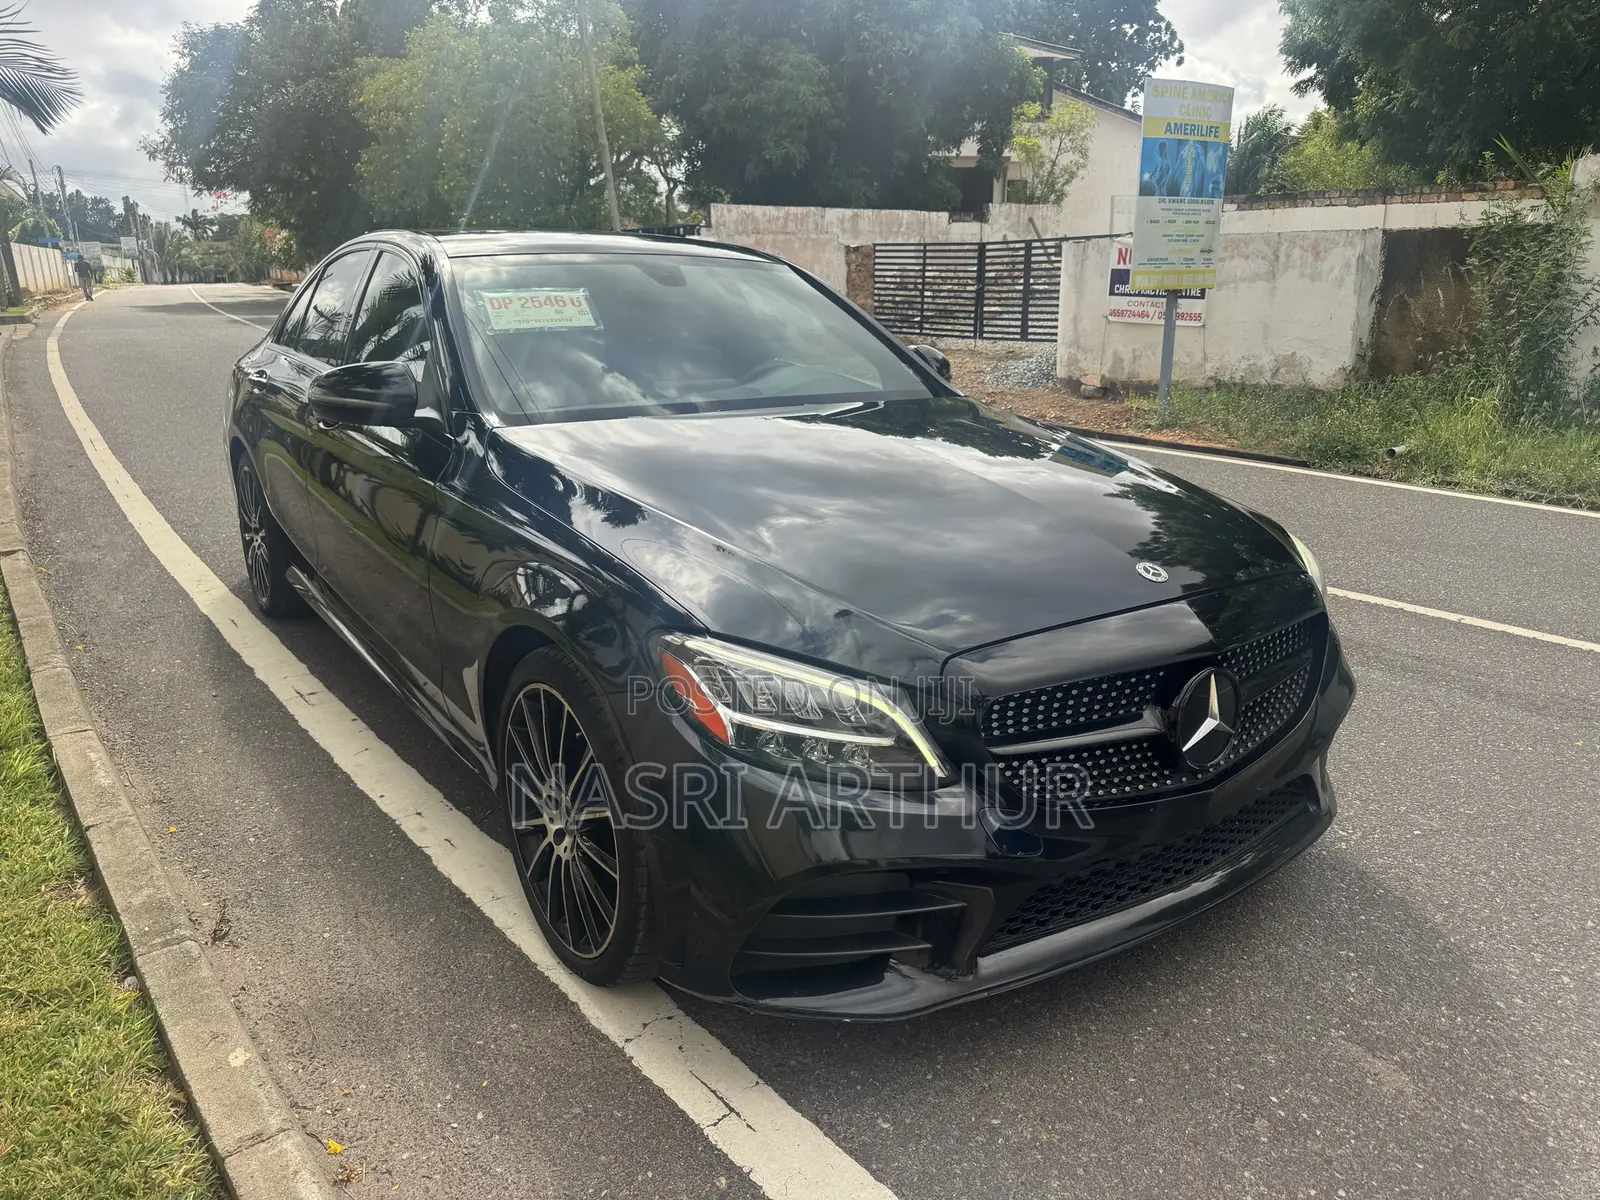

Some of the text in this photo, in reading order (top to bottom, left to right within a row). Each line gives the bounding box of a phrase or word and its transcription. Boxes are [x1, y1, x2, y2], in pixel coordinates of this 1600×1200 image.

[1152, 85, 1189, 99] SPINE
[1179, 103, 1212, 119] CLINIC
[1164, 122, 1220, 138] AMERILIFE
[488, 297, 513, 310] DP
[518, 295, 567, 309] 2546
[1127, 300, 1164, 308] CONTACT
